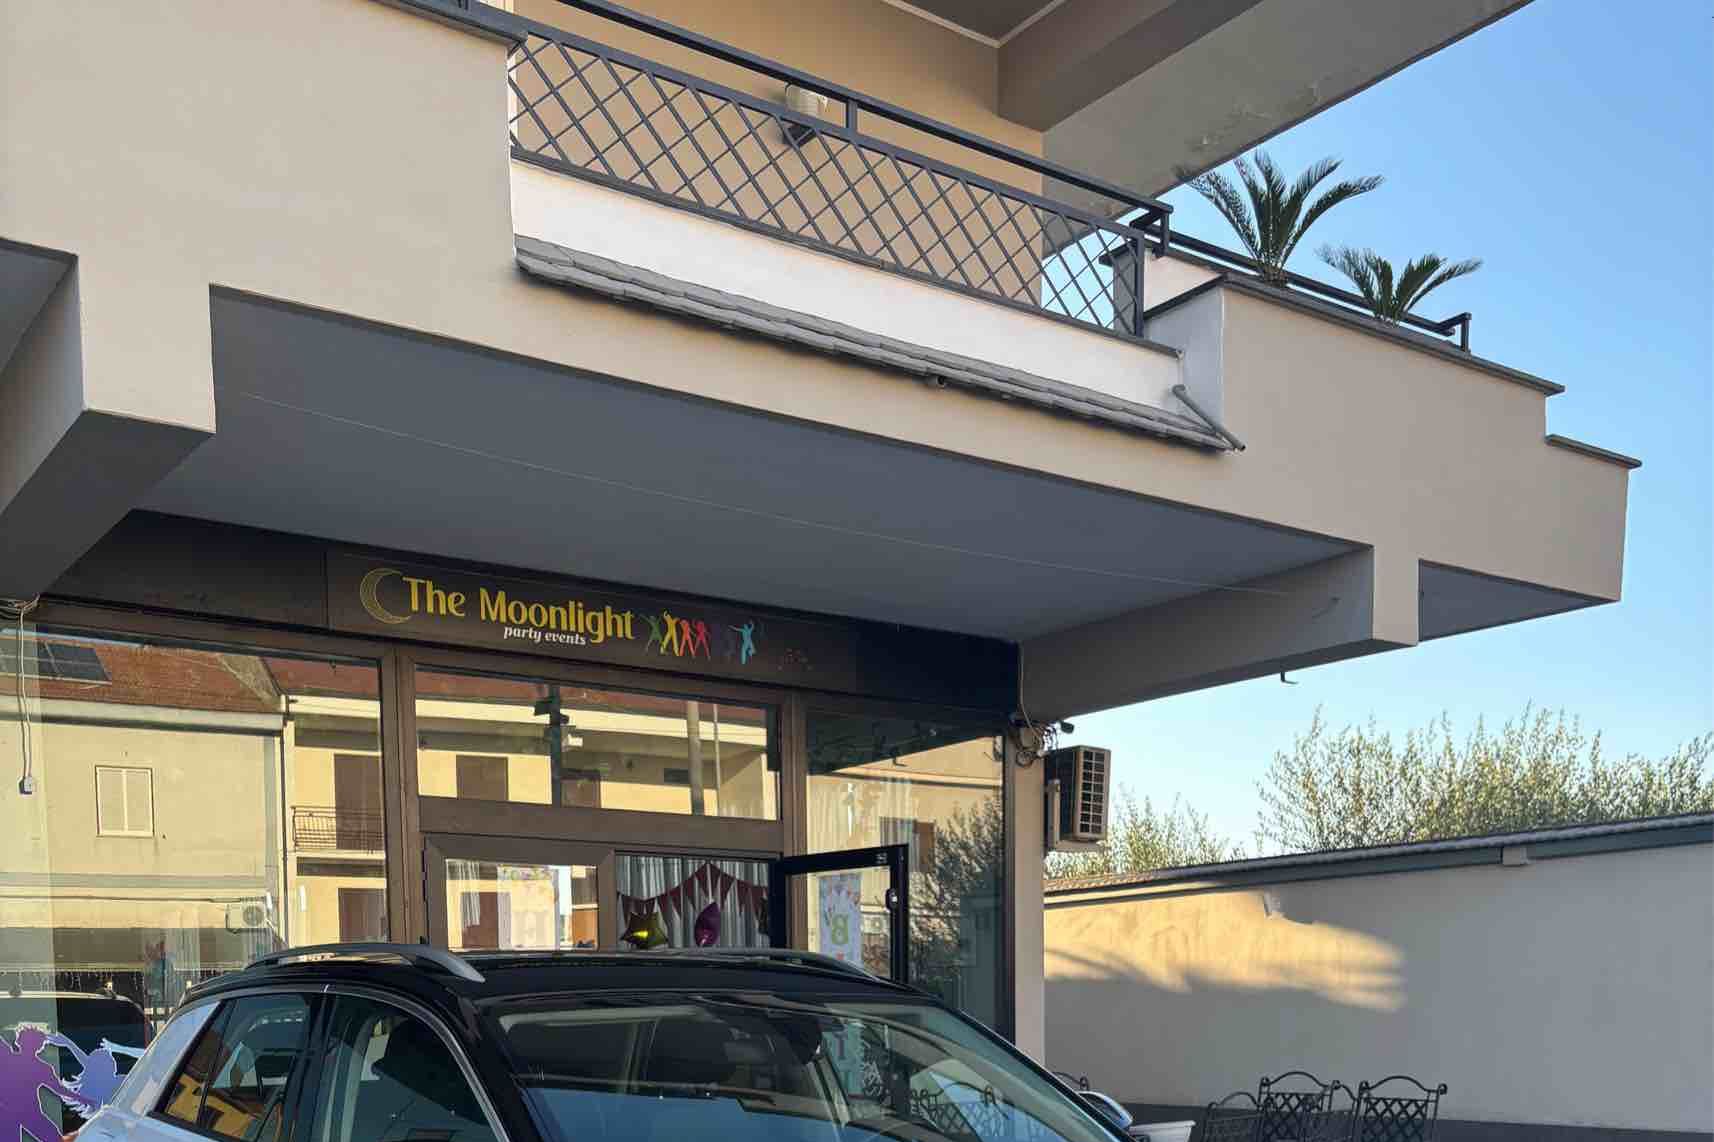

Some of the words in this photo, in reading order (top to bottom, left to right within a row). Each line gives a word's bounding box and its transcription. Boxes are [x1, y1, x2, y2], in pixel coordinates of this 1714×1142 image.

[402, 576, 465, 617] The
[479, 587, 635, 643] Moonlight
[503, 625, 542, 644] party
[544, 631, 586, 646] events
